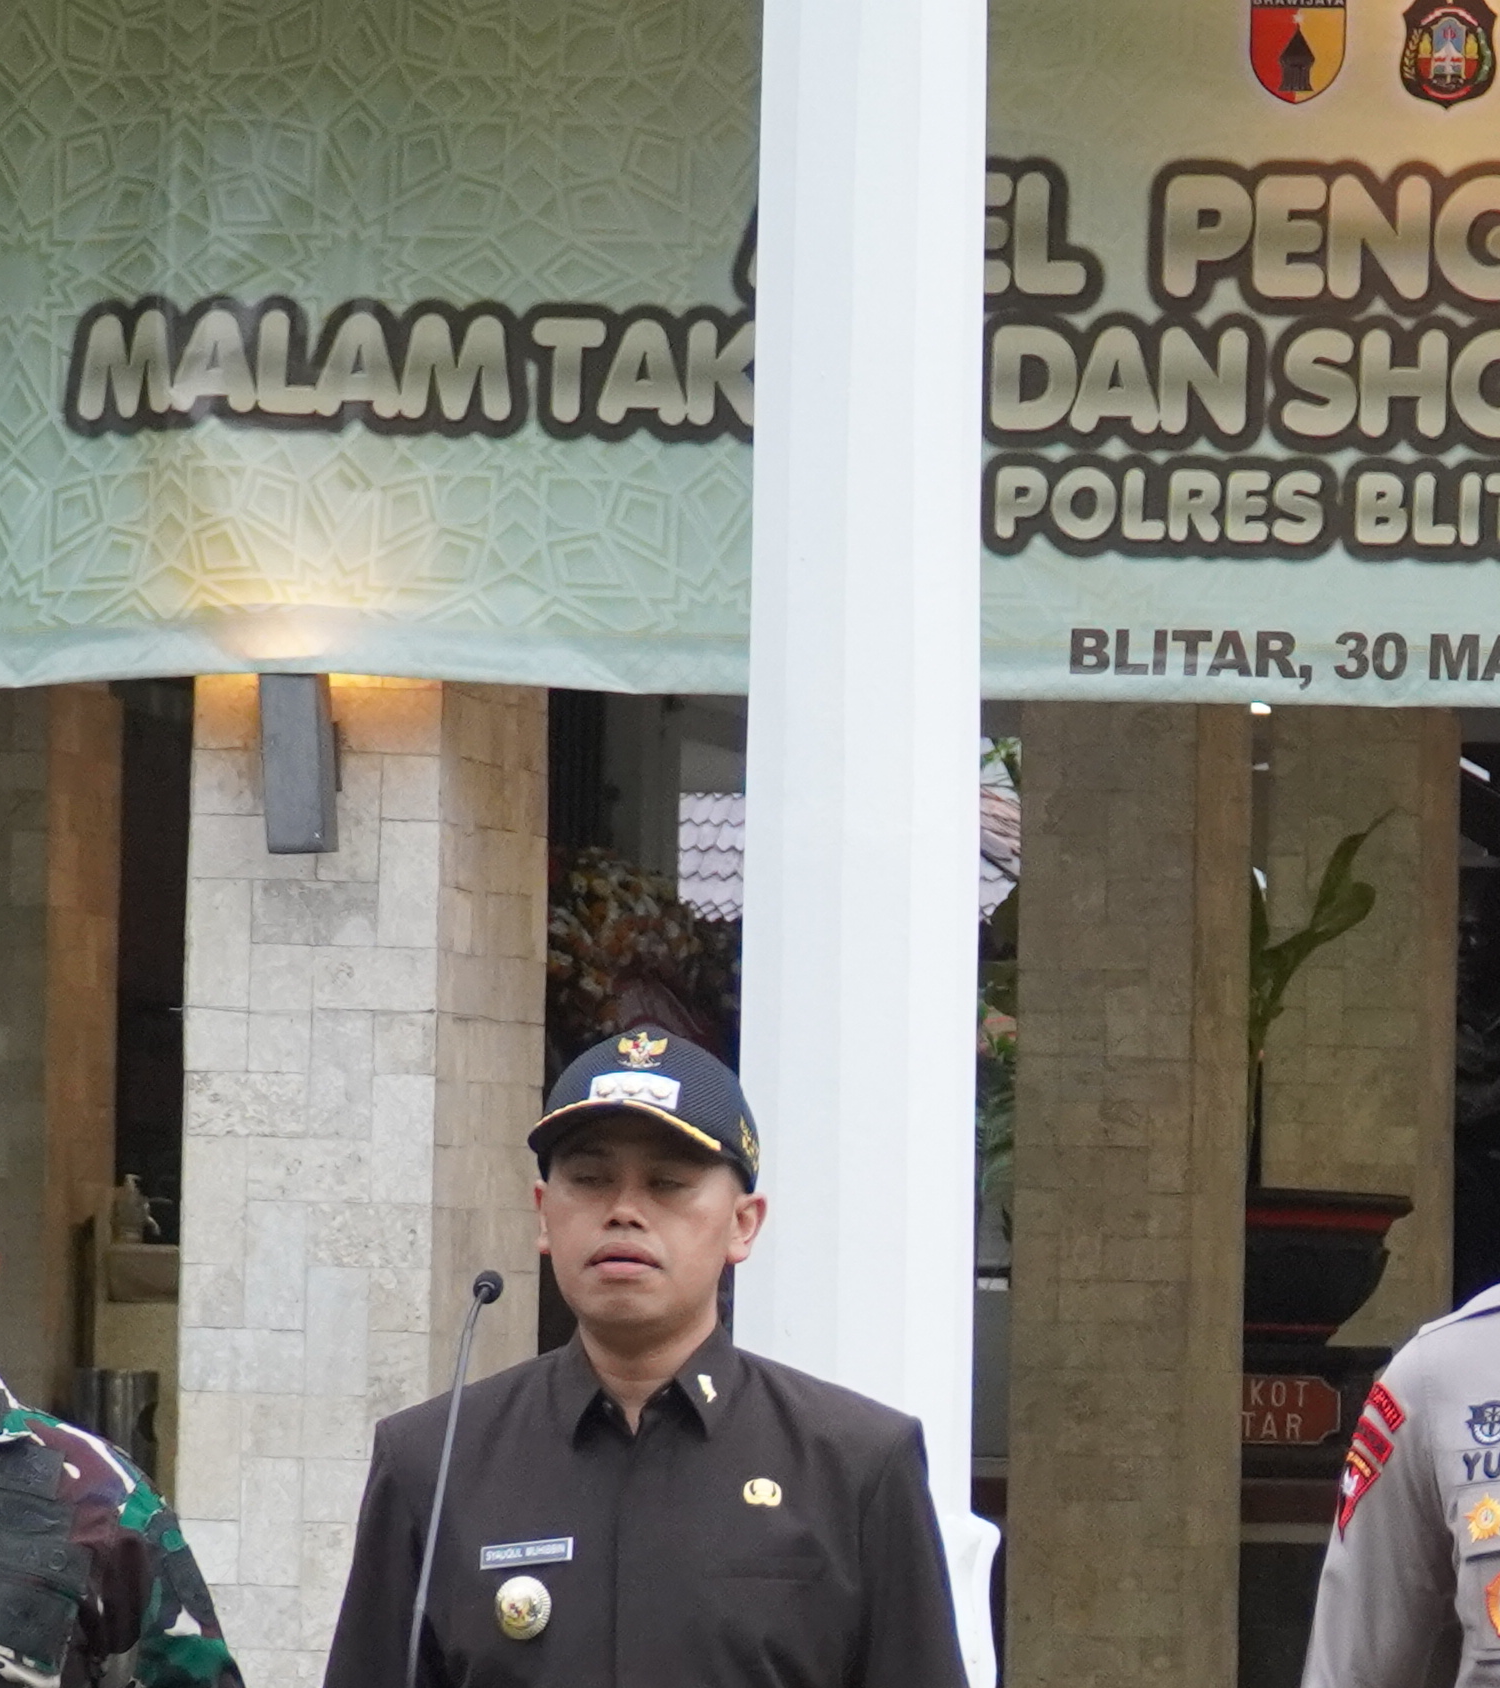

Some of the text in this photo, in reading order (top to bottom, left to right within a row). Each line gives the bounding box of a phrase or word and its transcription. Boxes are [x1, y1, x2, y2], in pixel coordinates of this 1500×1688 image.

[74, 308, 514, 424] MALAM
[988, 322, 1252, 439] DAN
[990, 464, 1324, 545] POLRES
[1067, 626, 1315, 691] BLITAR,
[1332, 630, 1410, 683] 30
[1250, 1378, 1310, 1408] KOT
